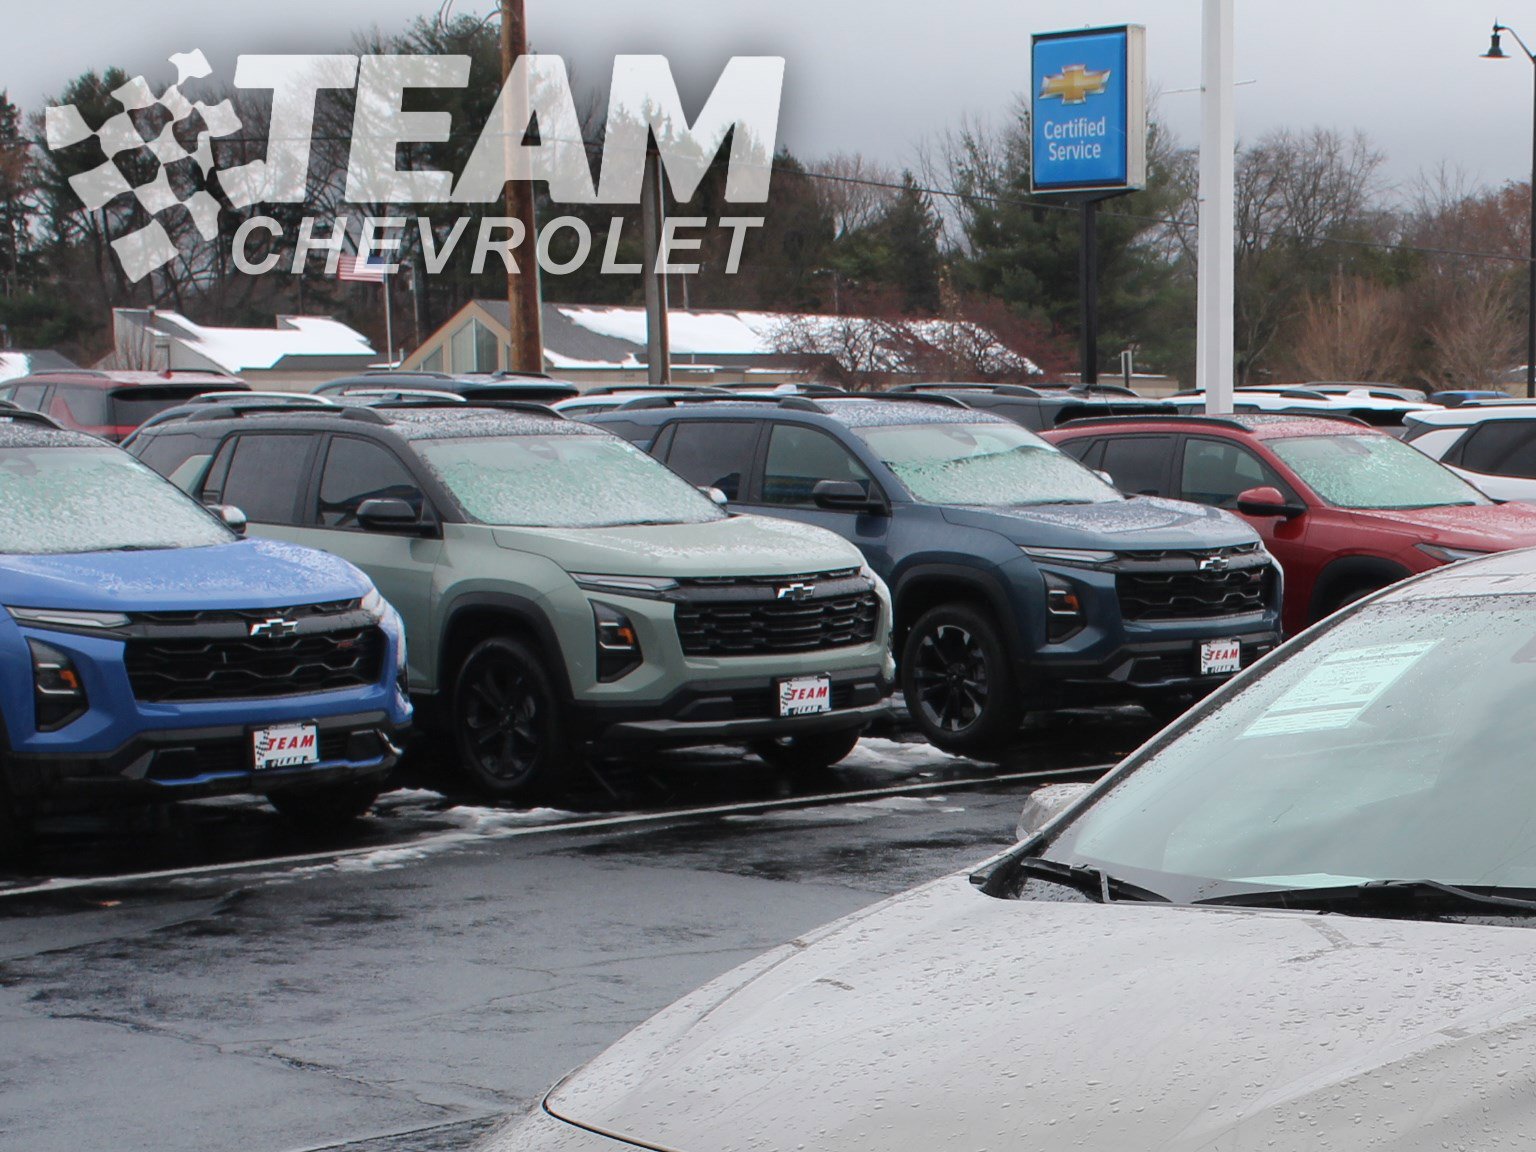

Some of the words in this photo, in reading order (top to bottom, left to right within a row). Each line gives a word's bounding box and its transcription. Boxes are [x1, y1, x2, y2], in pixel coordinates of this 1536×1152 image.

[1044, 116, 1106, 140] Certified
[1048, 140, 1102, 161] Service
[1209, 648, 1238, 661] TEAM
[790, 686, 828, 700] TEAM
[266, 734, 315, 751] TEAM
